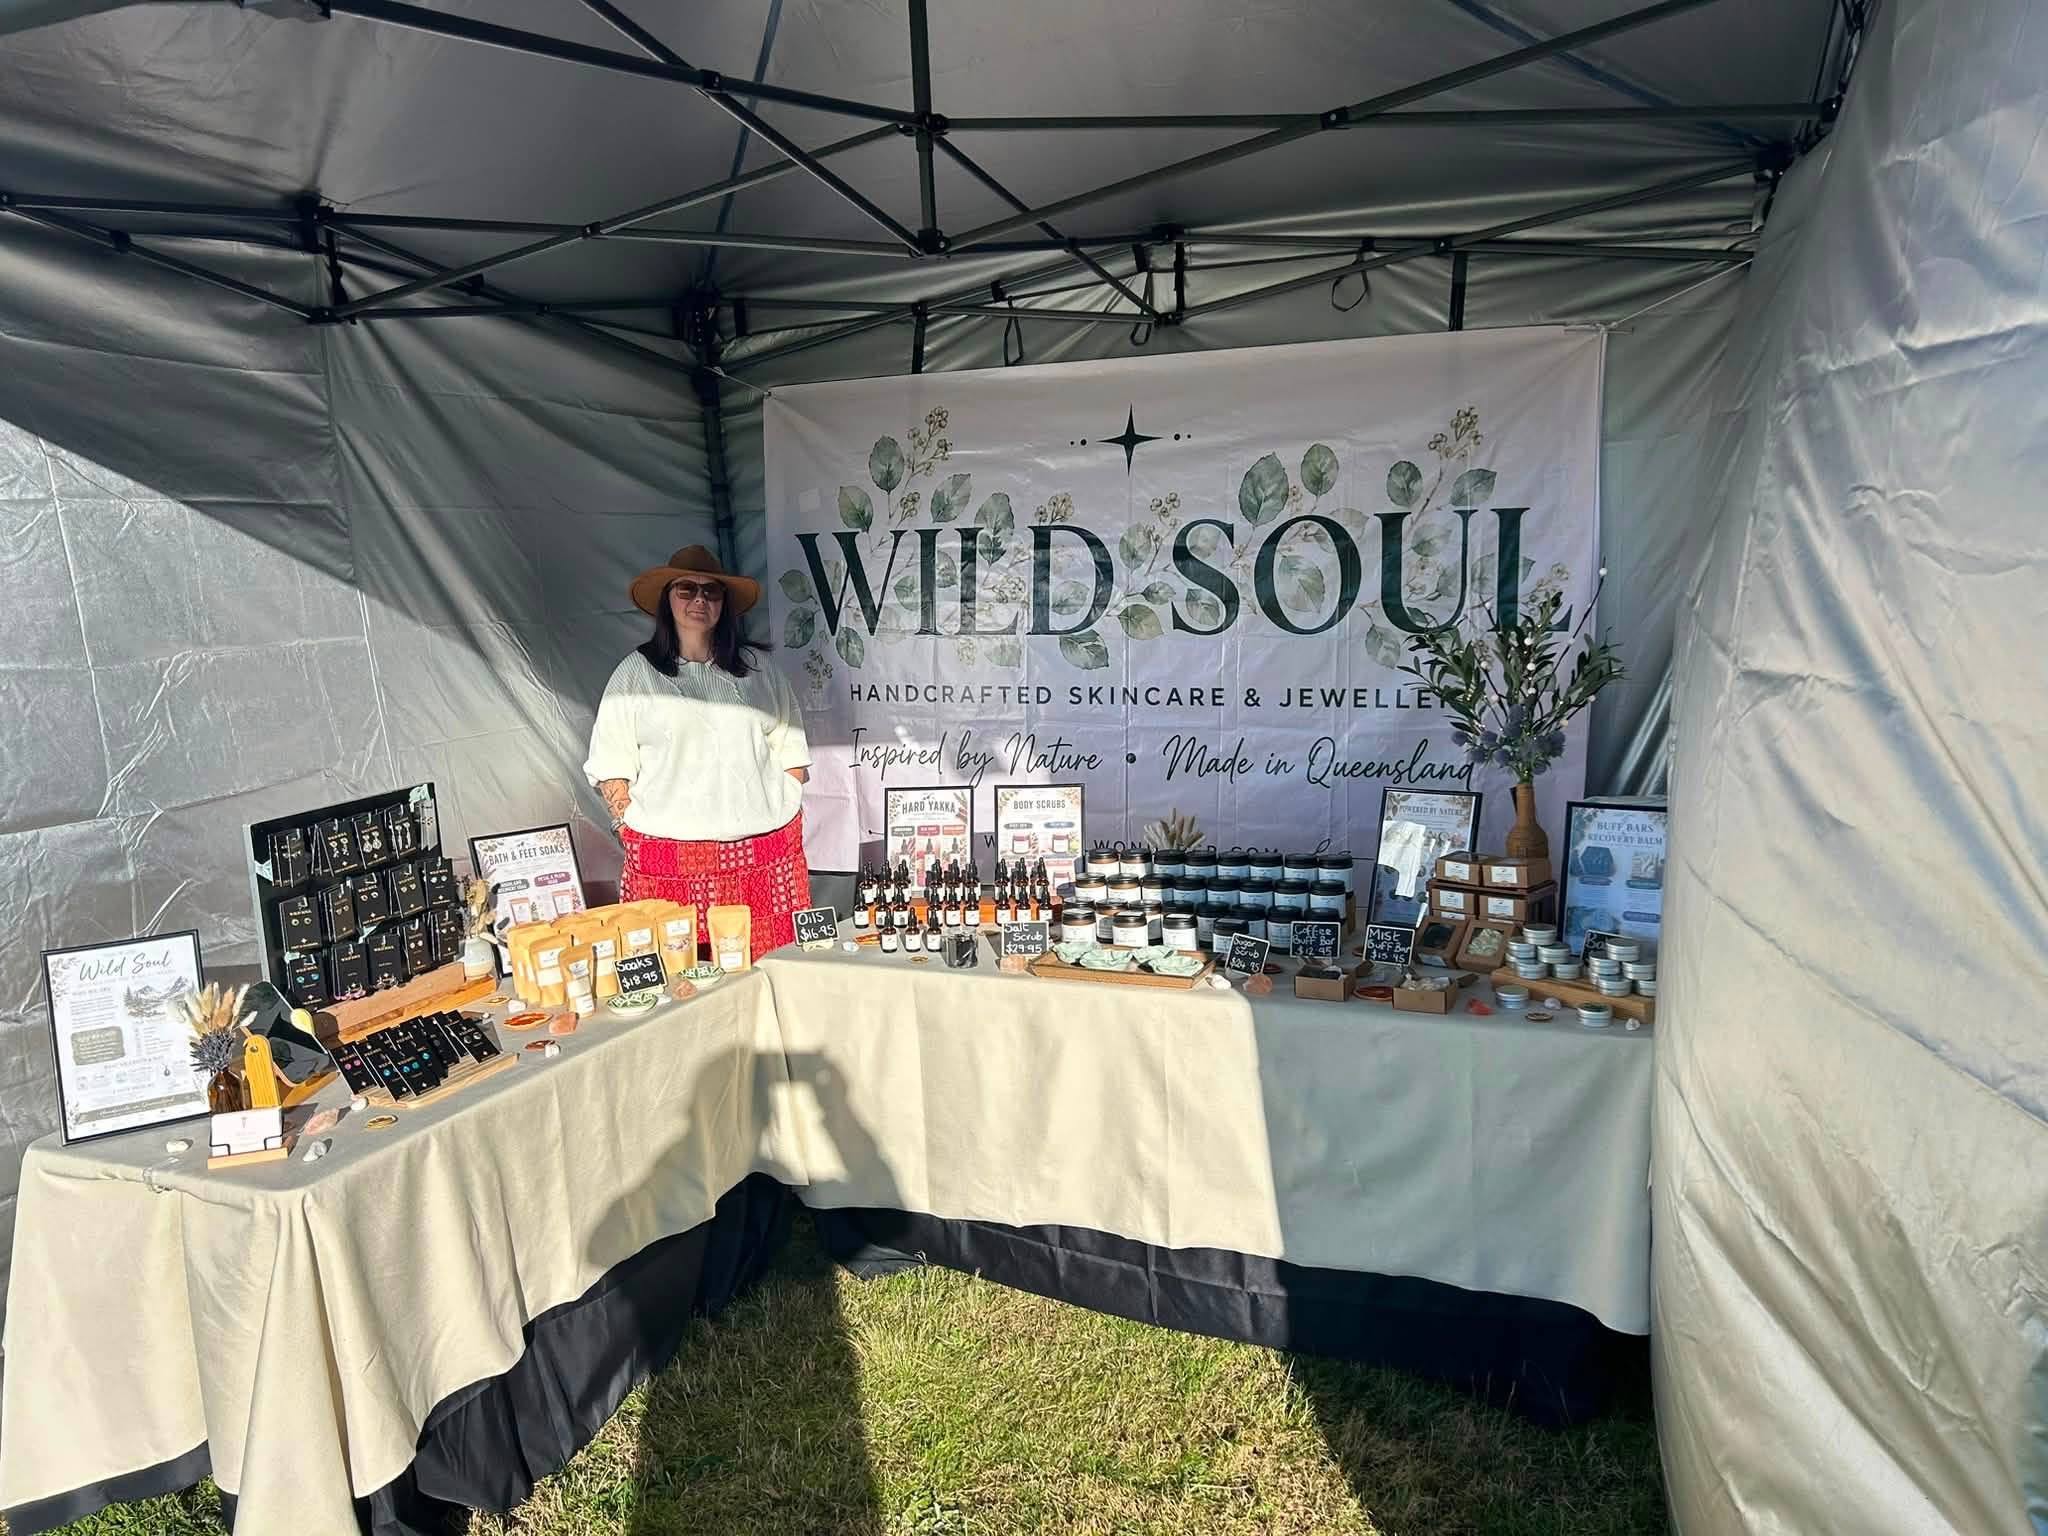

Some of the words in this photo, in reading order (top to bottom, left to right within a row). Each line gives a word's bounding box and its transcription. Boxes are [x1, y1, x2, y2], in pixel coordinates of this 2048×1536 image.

[795, 523, 1114, 637] WILD
[1172, 507, 1573, 635] SOUL
[850, 683, 1052, 705] HANDCRAFTED
[1070, 686, 1224, 708] SKINCARE
[1244, 688, 1262, 708] &
[1280, 687, 1446, 709] JEWELLE
[848, 728, 947, 781] Inspired
[956, 730, 994, 788] by
[1004, 732, 1102, 778] Nature
[1163, 734, 1254, 784] Made
[1265, 752, 1295, 776] in
[902, 801, 925, 814] HARD
[928, 800, 956, 813] YAKKA
[1013, 800, 1034, 809] BODY
[1036, 799, 1066, 809] SCRUBS
[1626, 823, 1654, 833] BARS
[489, 852, 509, 865] BATH
[511, 850, 517, 861] &
[519, 847, 538, 858] FEET
[540, 844, 565, 856] SOAKS
[1004, 922, 1029, 933] Salt
[1295, 924, 1332, 938] Coffee
[1369, 928, 1400, 941] Mist
[1012, 931, 1043, 941] Scrub
[1233, 935, 1256, 950] Sugar
[1319, 935, 1336, 945] Bar
[1234, 946, 1260, 958] Scrub
[80, 957, 126, 981] Wild
[132, 951, 170, 974] Soul
[616, 957, 653, 972] Soaks
